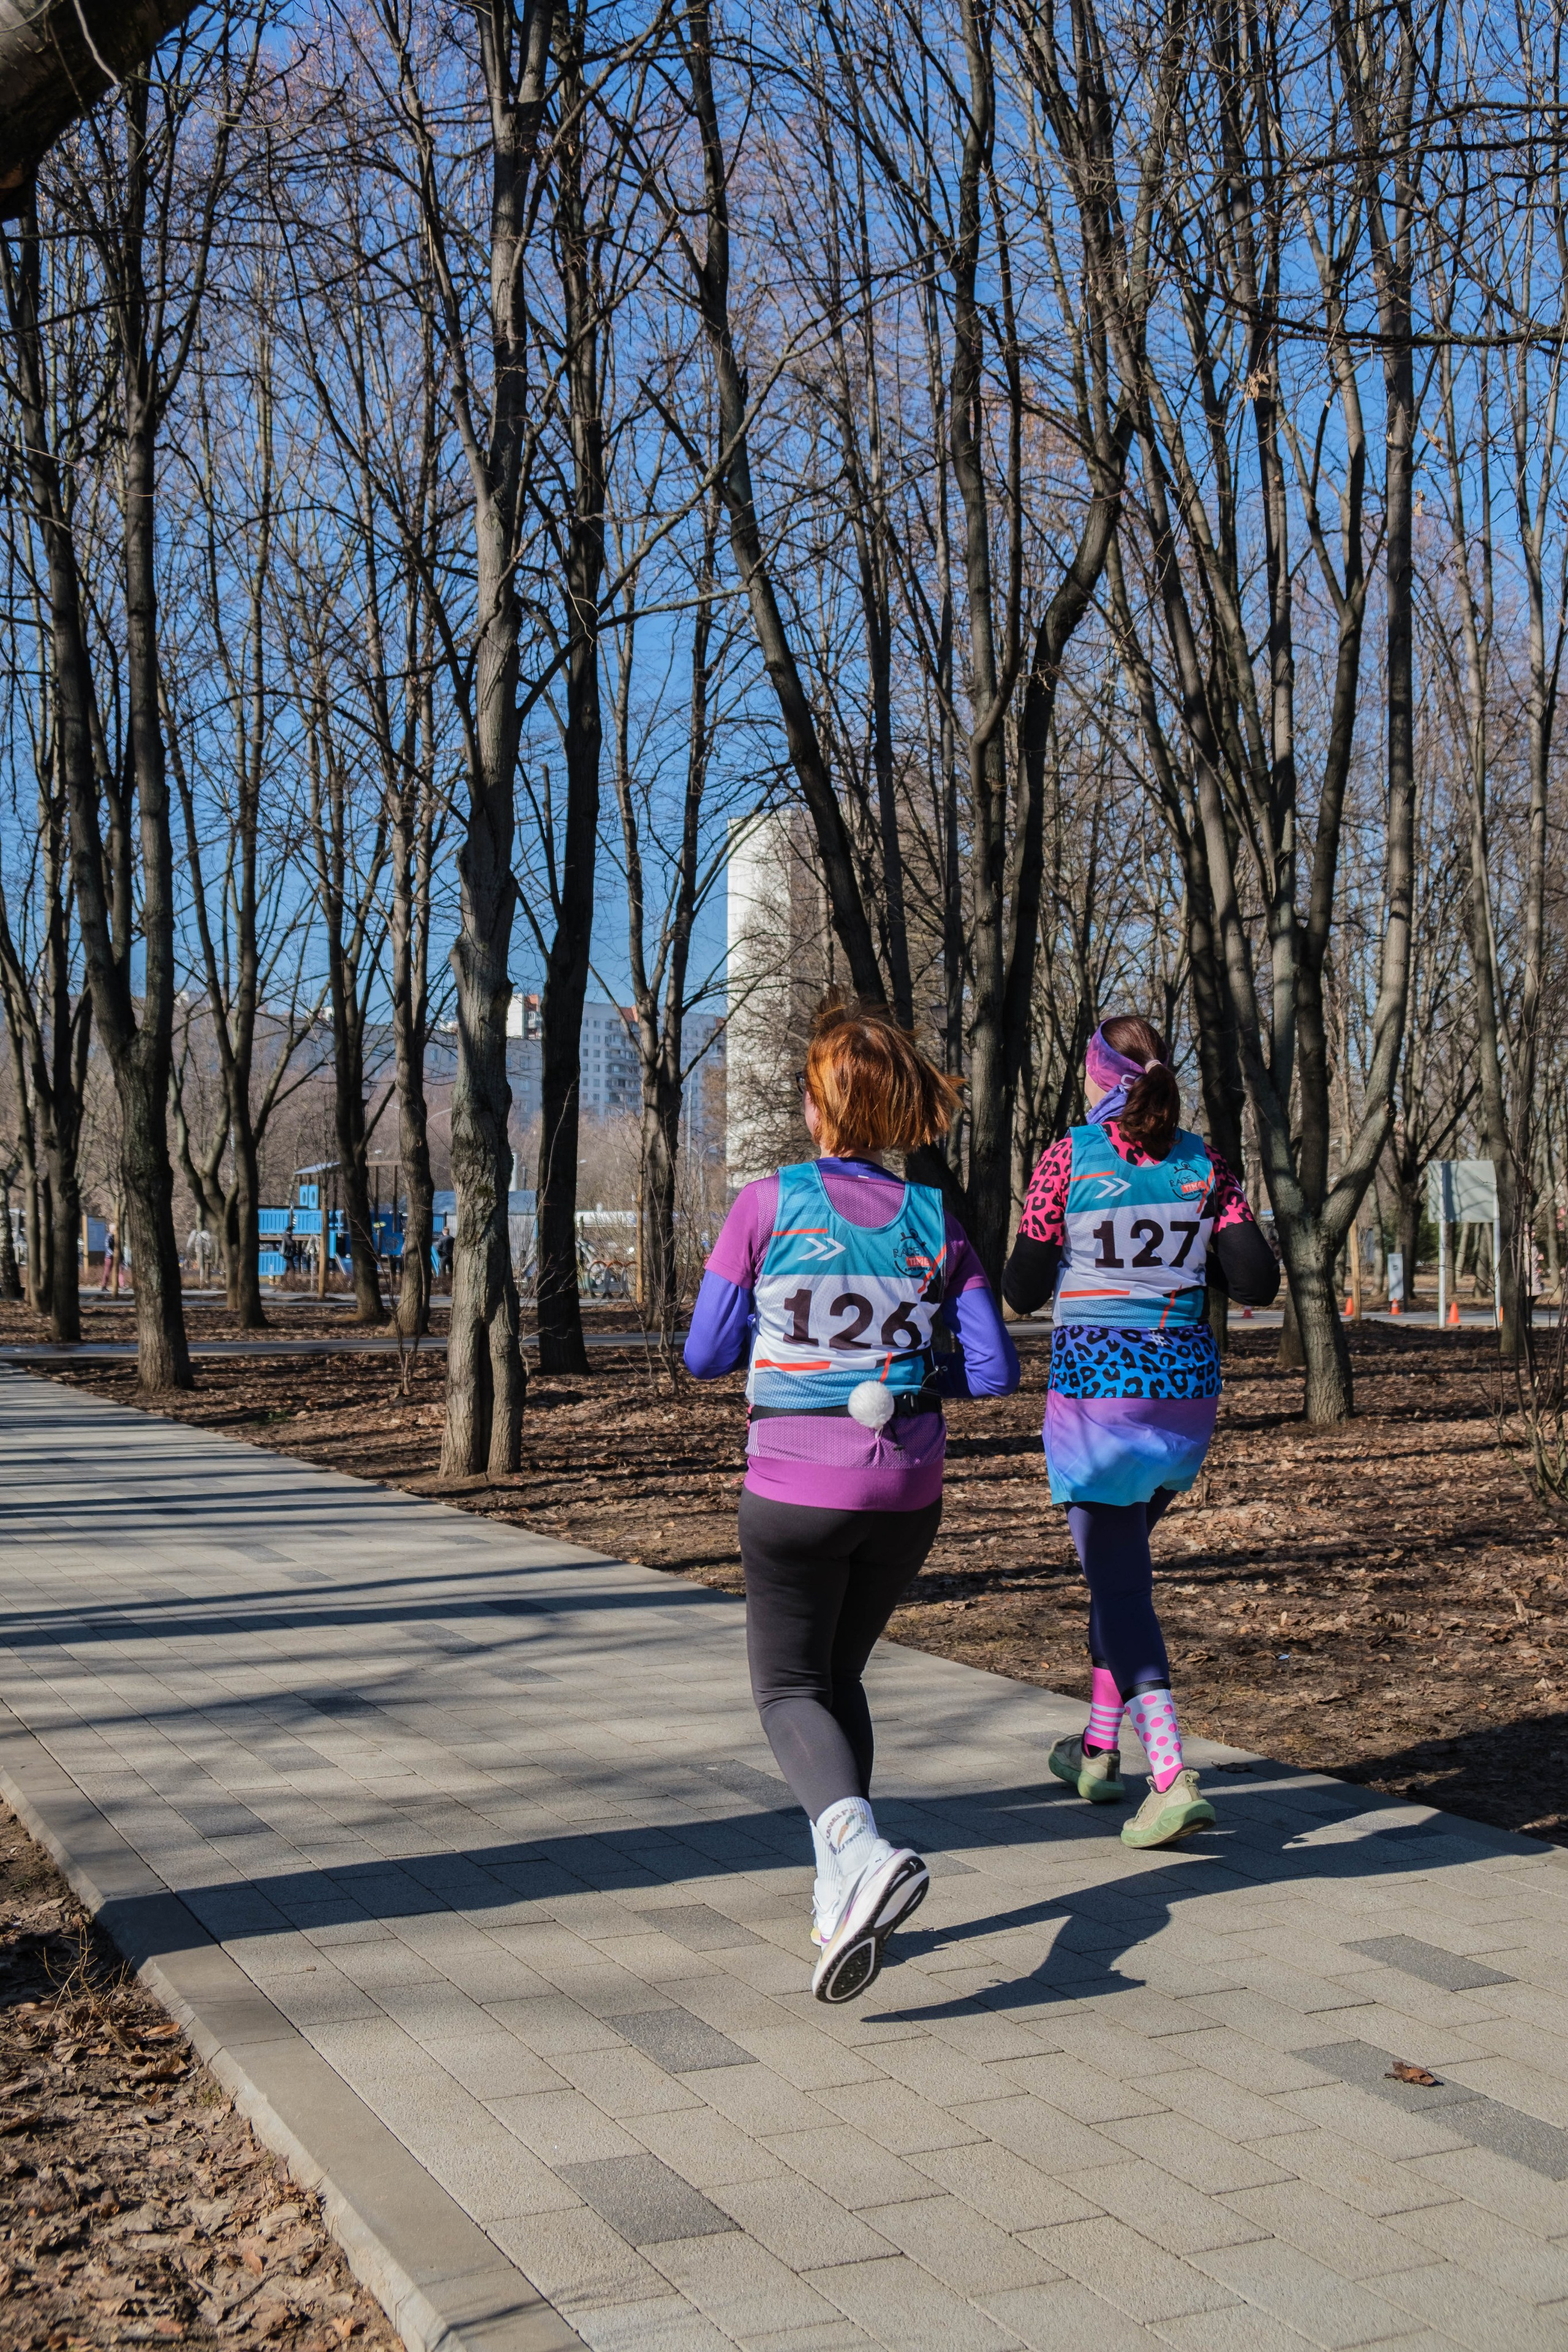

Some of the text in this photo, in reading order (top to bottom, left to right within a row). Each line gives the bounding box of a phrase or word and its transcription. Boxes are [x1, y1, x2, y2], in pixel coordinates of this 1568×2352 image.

[1169, 1175, 1193, 1188] RACE
[1183, 1182, 1202, 1193] TIME
[1093, 1219, 1200, 1268] 127
[892, 1246, 920, 1258] RACE
[908, 1256, 930, 1267] TIME
[783, 1289, 922, 1351] 126
